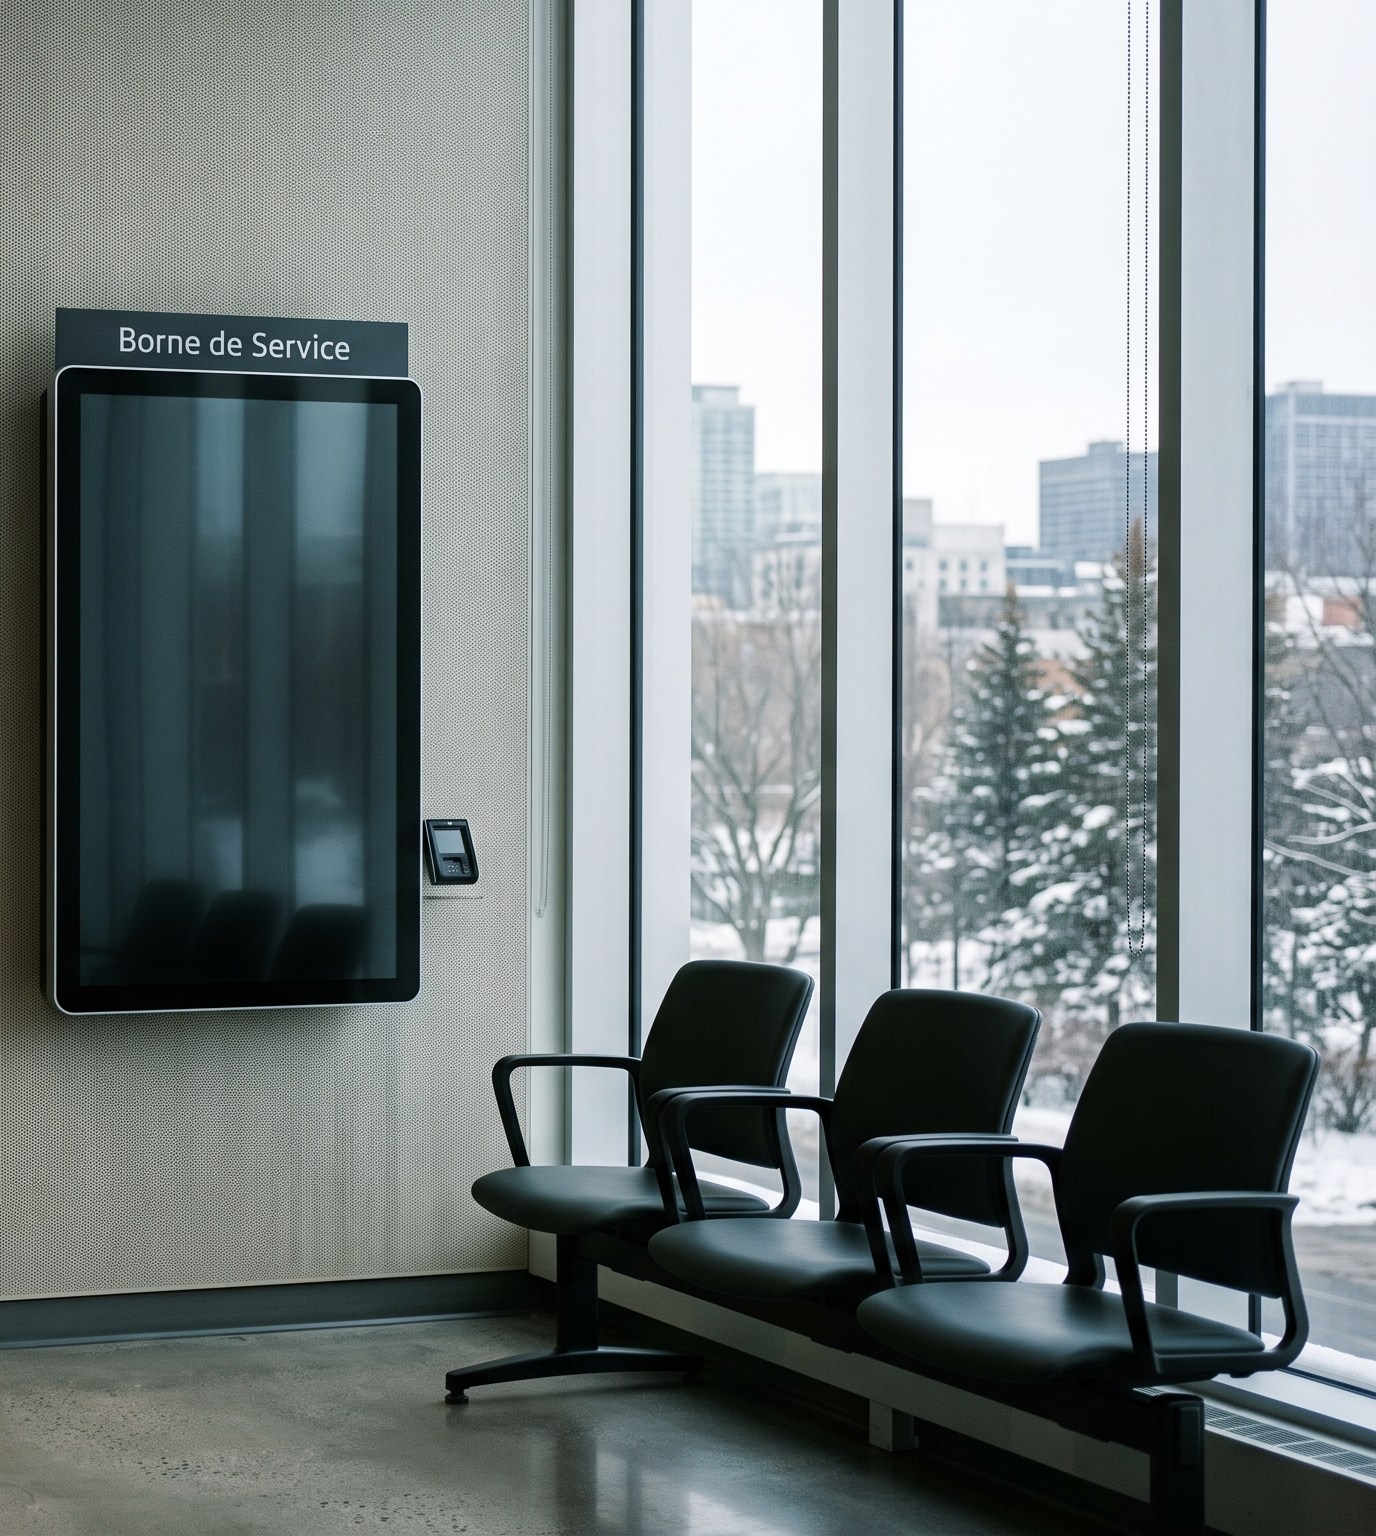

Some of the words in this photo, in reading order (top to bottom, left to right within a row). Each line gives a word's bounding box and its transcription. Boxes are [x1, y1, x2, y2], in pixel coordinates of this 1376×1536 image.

[119, 326, 201, 355] Borne
[209, 330, 243, 357] de
[252, 332, 350, 361] Service
